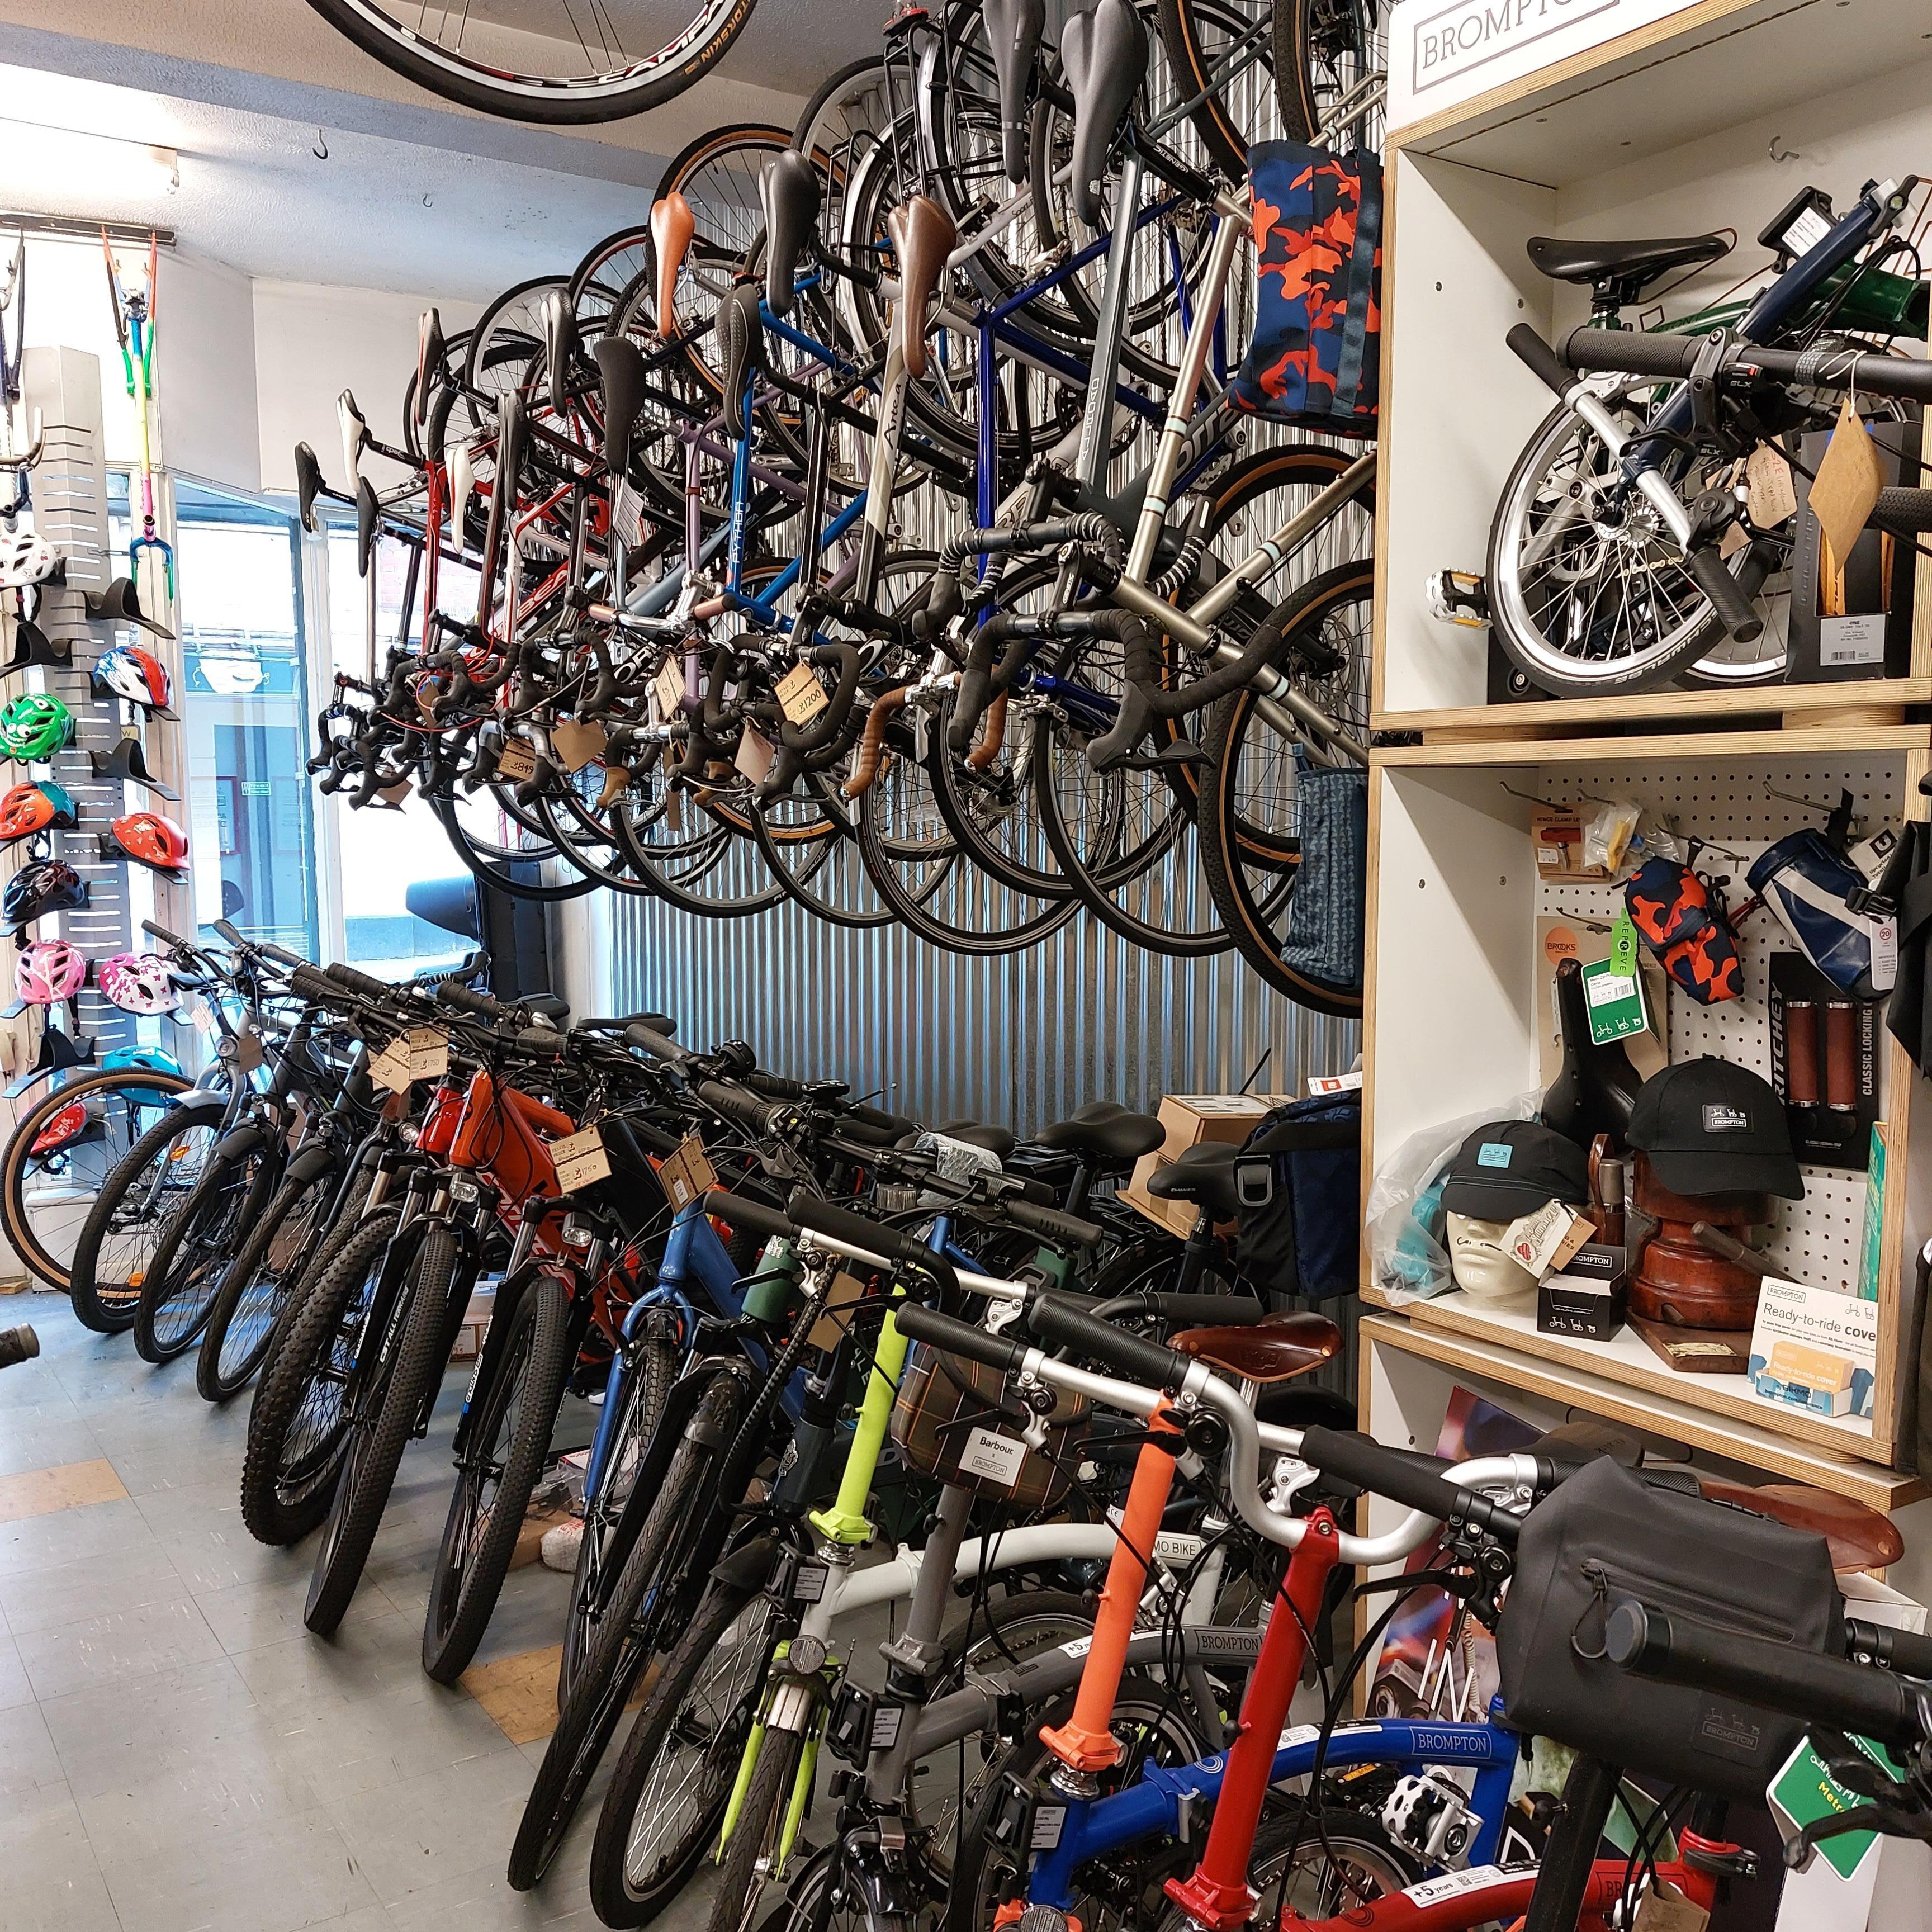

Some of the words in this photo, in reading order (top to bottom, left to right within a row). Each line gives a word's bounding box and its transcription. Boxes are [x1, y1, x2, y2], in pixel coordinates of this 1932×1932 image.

[700, 0, 751, 63] TORSKIN
[1423, 0, 1570, 70] BROMP
[1153, 145, 1189, 173] GENETIC
[1081, 377, 1100, 461] ALLROAD
[732, 501, 744, 564] PYTHON
[799, 689, 822, 714] £1200
[510, 761, 534, 774] £849
[1547, 943, 1576, 951] BROOKS
[1619, 921, 1630, 972] REPREVE
[1862, 1008, 1873, 1052] LOCKING
[1772, 982, 1786, 1106] RITCHEY
[1862, 1053, 1873, 1096] CLASSIC
[1770, 1287, 1803, 1301] BROMPTON
[1763, 1303, 1841, 1333] Ready-to-ride
[1845, 1326, 1876, 1342] cove
[974, 1459, 1005, 1473] BROMPTON
[1153, 1540, 1169, 1552] MO
[1172, 1542, 1196, 1556] BIKE
[1201, 1635, 1258, 1651] BROMPTON
[1418, 1734, 1487, 1753] BROMPTON
[1705, 1724, 1755, 1747] BROMPTON
[1414, 1885, 1434, 1898] +5
[1434, 1881, 1455, 1895] years
